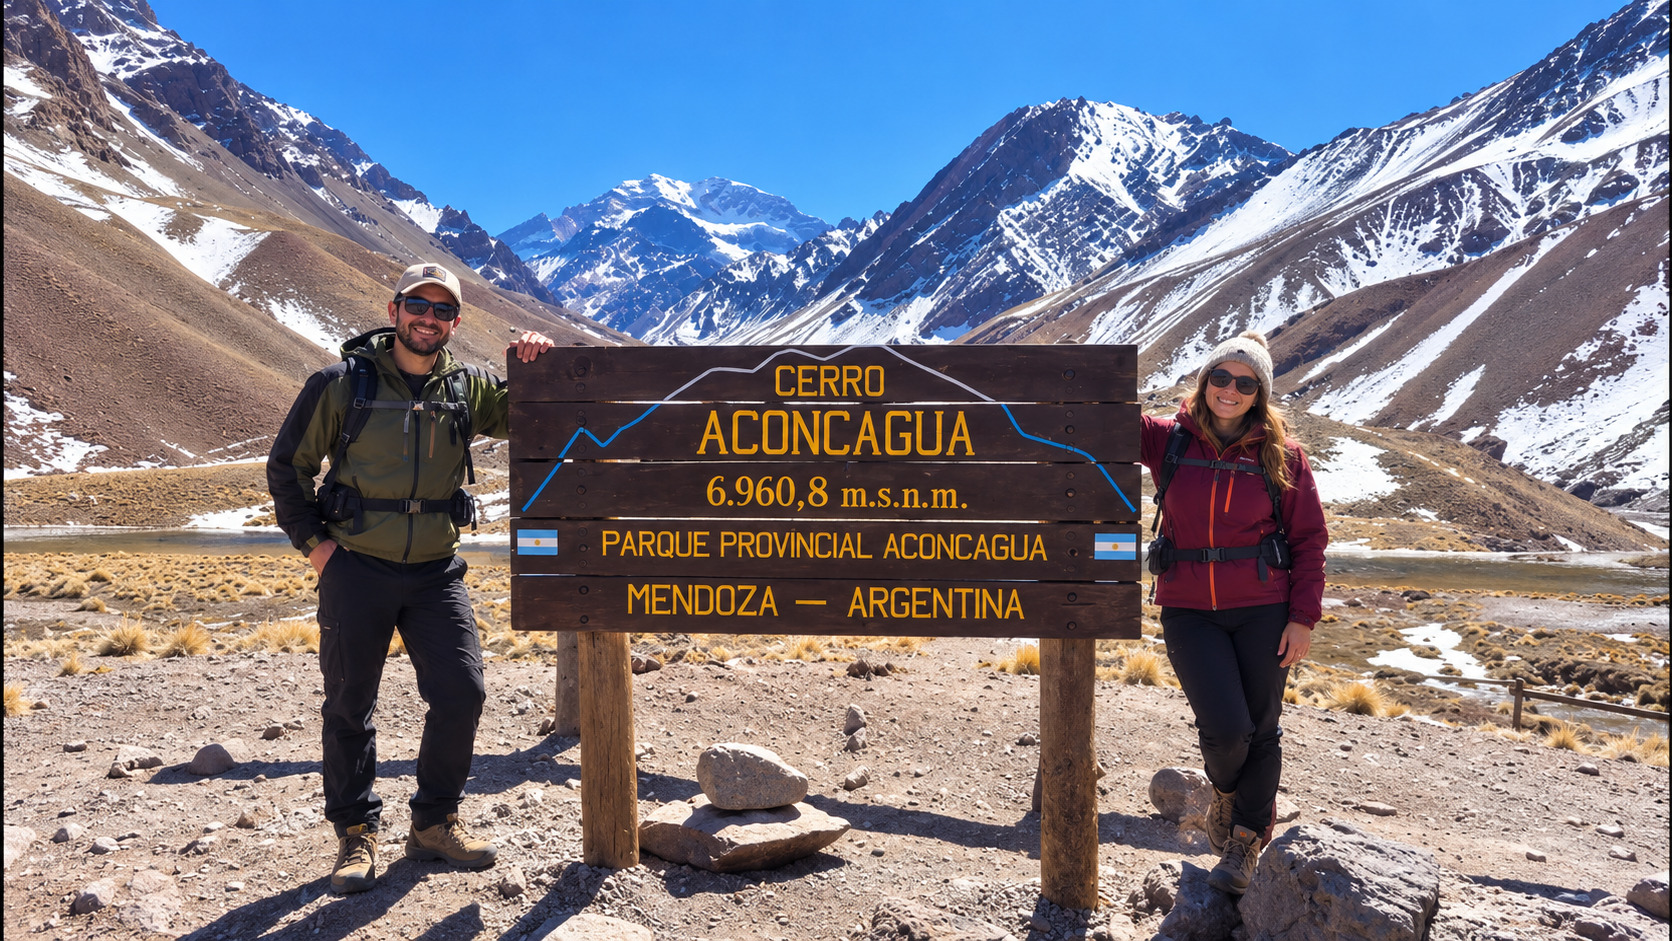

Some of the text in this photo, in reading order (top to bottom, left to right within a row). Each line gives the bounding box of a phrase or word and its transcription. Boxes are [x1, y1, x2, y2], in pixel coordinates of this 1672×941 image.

[774, 364, 885, 397] CERRO
[696, 409, 976, 456] ACONCAGUA
[706, 475, 968, 512] 6.960,8 m.s.n.m.
[601, 529, 1048, 562] PARQUE PROVINCIAL ACONCAGUA
[627, 583, 779, 617] MENDOZA
[847, 586, 1025, 620] ARGENTINA
